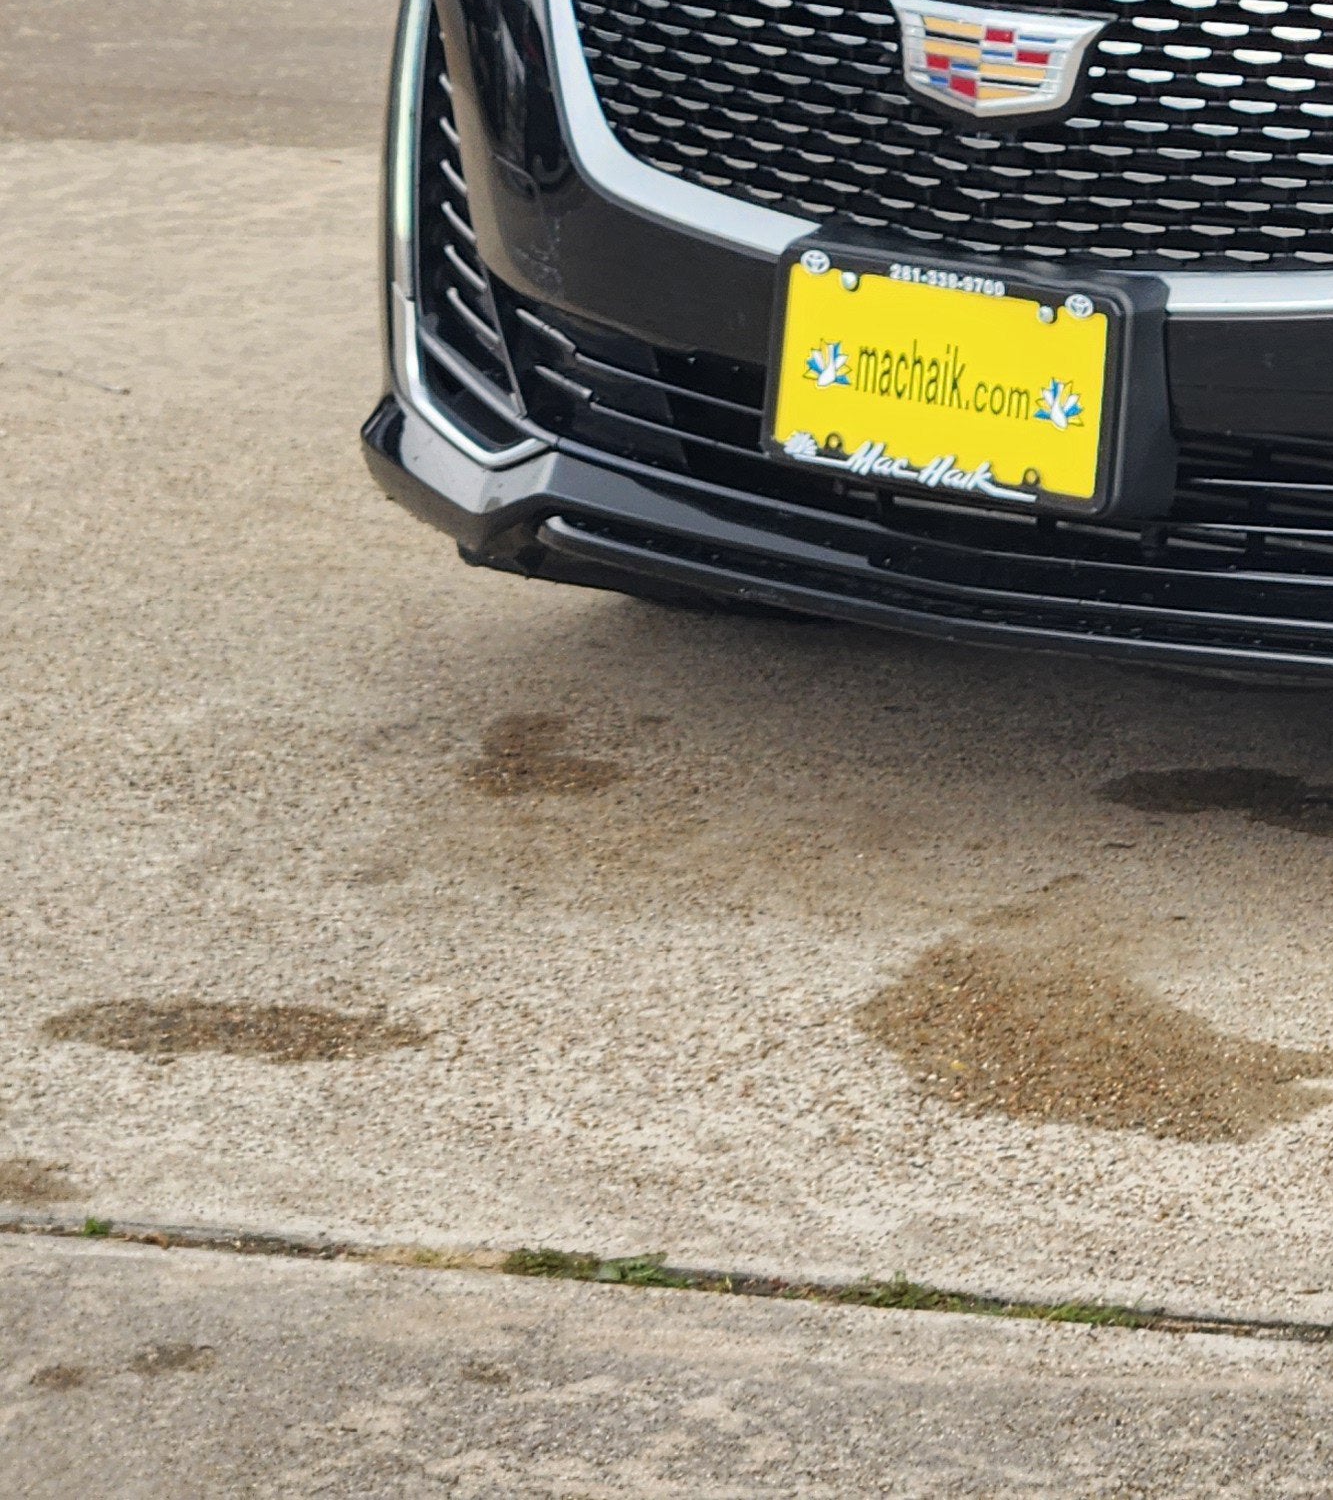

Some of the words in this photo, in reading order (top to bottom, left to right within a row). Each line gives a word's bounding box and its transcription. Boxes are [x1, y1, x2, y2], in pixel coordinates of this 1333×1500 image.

[855, 338, 1031, 421] machaik.com
[847, 440, 919, 478] Mac
[917, 455, 1032, 501] Haik
